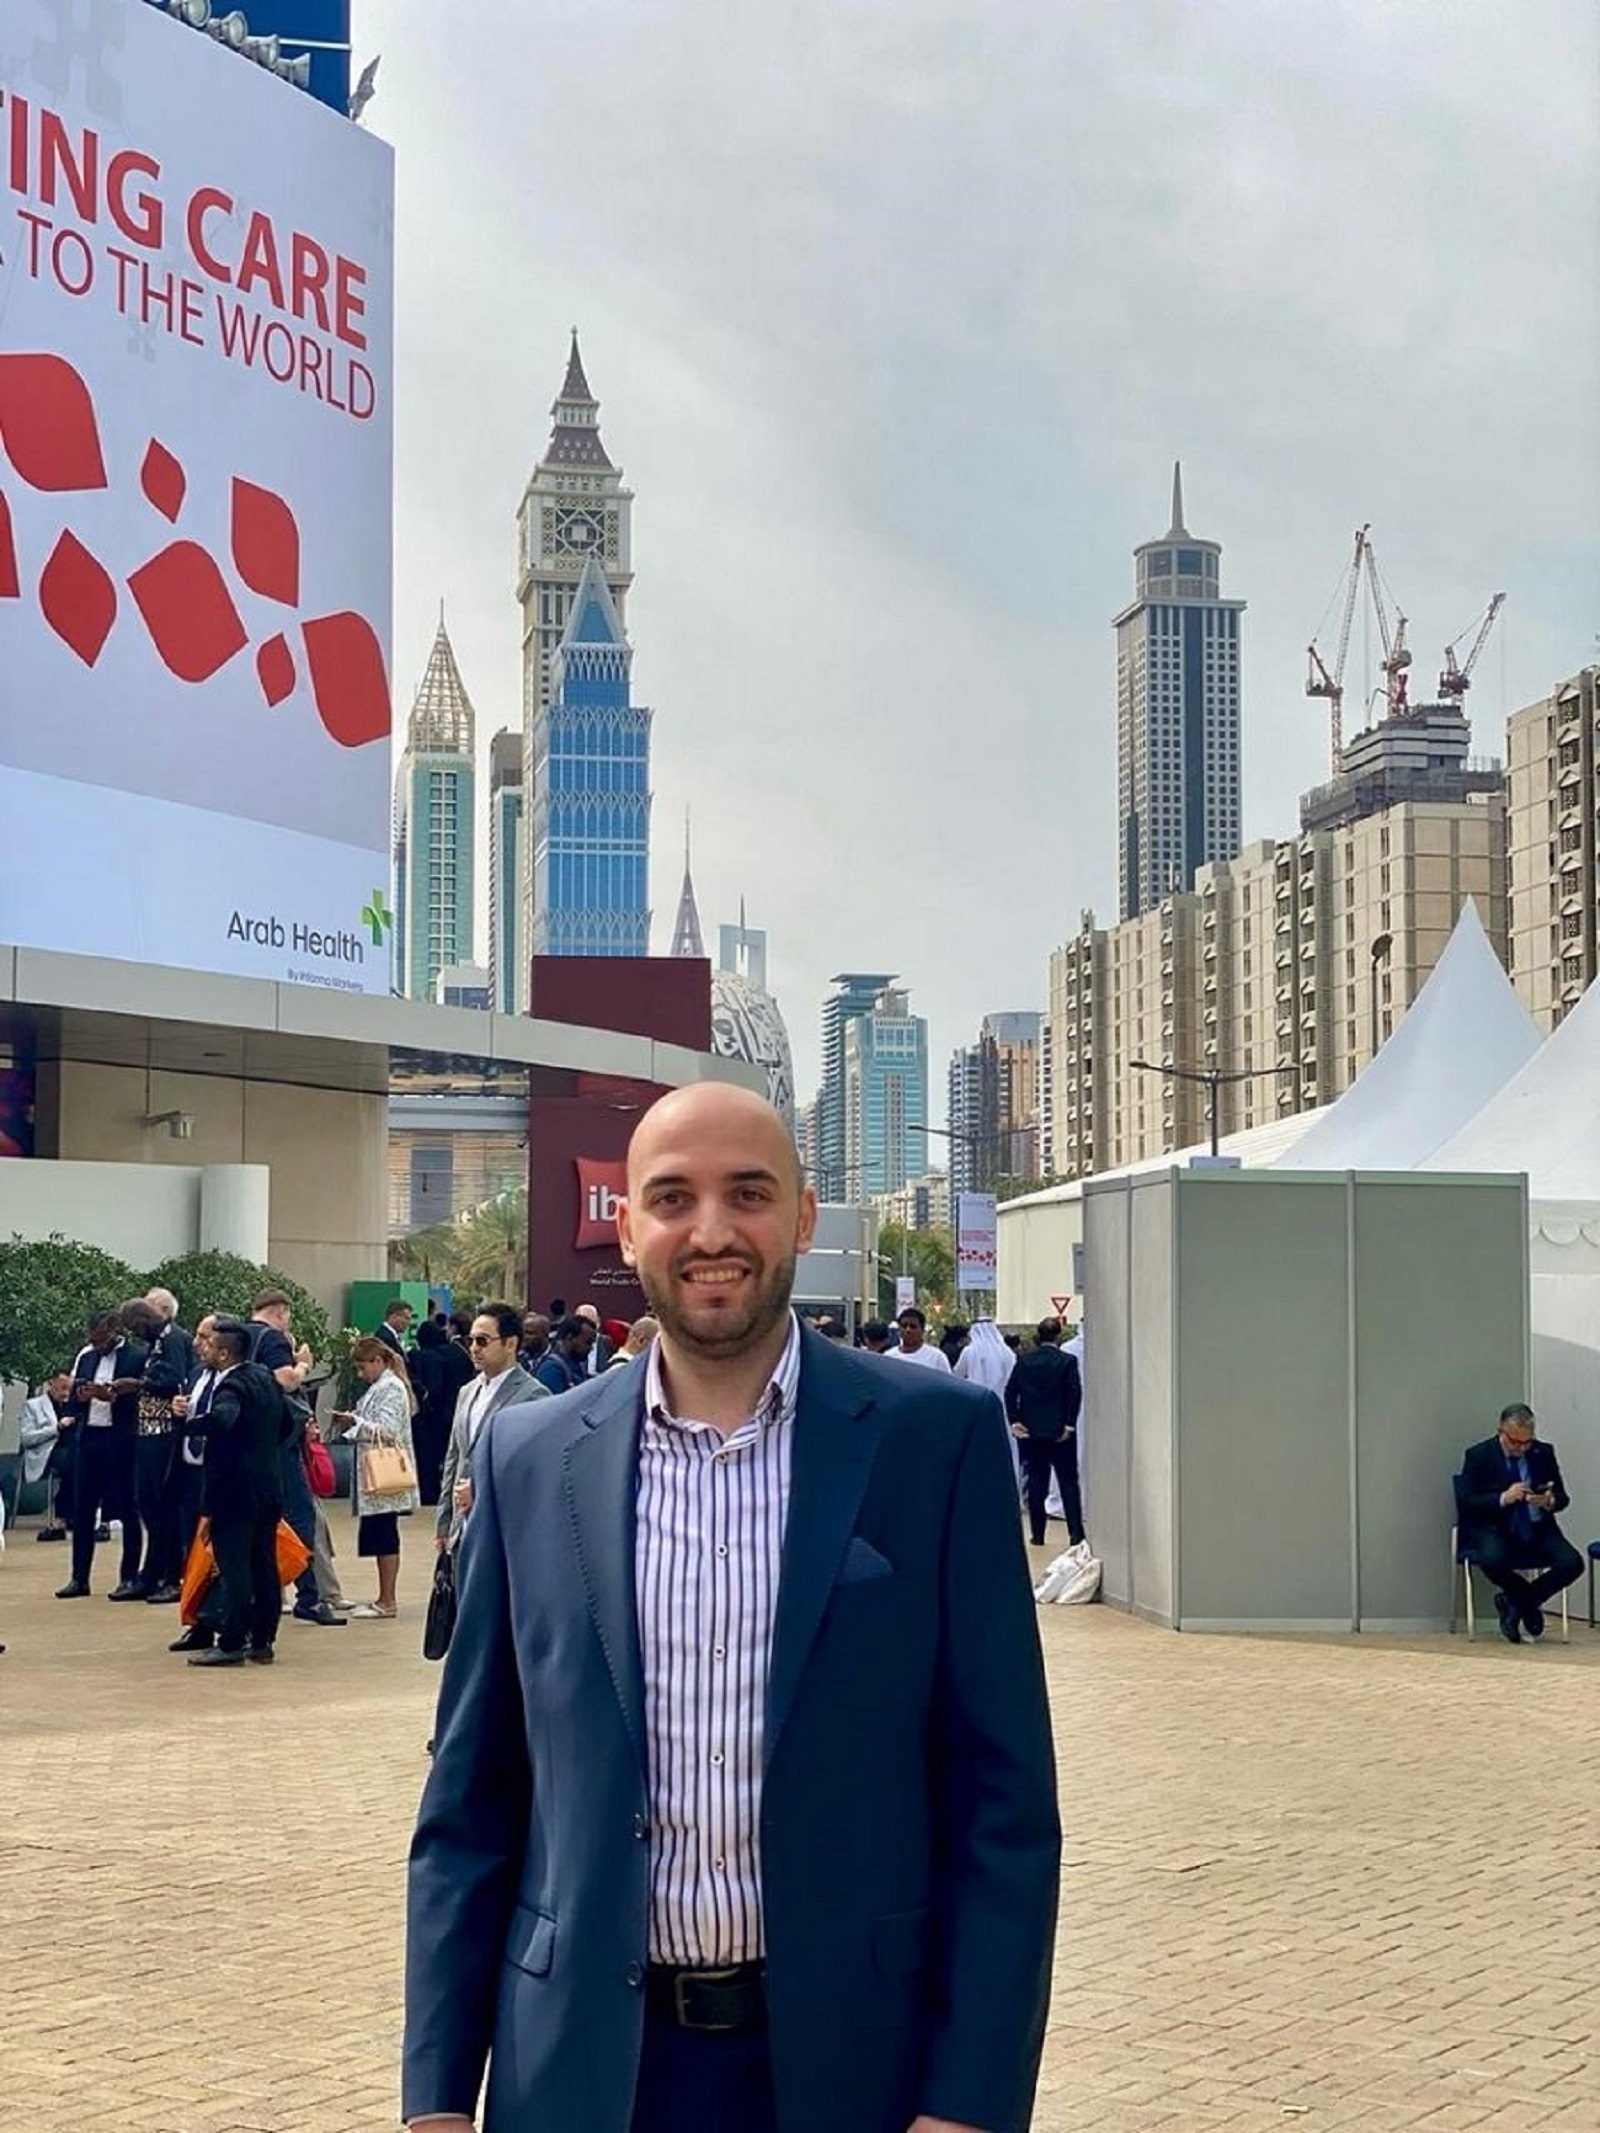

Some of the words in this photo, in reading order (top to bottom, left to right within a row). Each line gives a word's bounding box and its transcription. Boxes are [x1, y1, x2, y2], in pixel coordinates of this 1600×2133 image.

[0, 91, 163, 249] ING
[187, 187, 367, 351] CARE
[17, 209, 94, 295] TO
[106, 246, 204, 346] THE
[215, 294, 376, 420] WORLD
[227, 910, 285, 948] Arab
[292, 922, 364, 964] Health
[588, 1185, 618, 1222] ib
